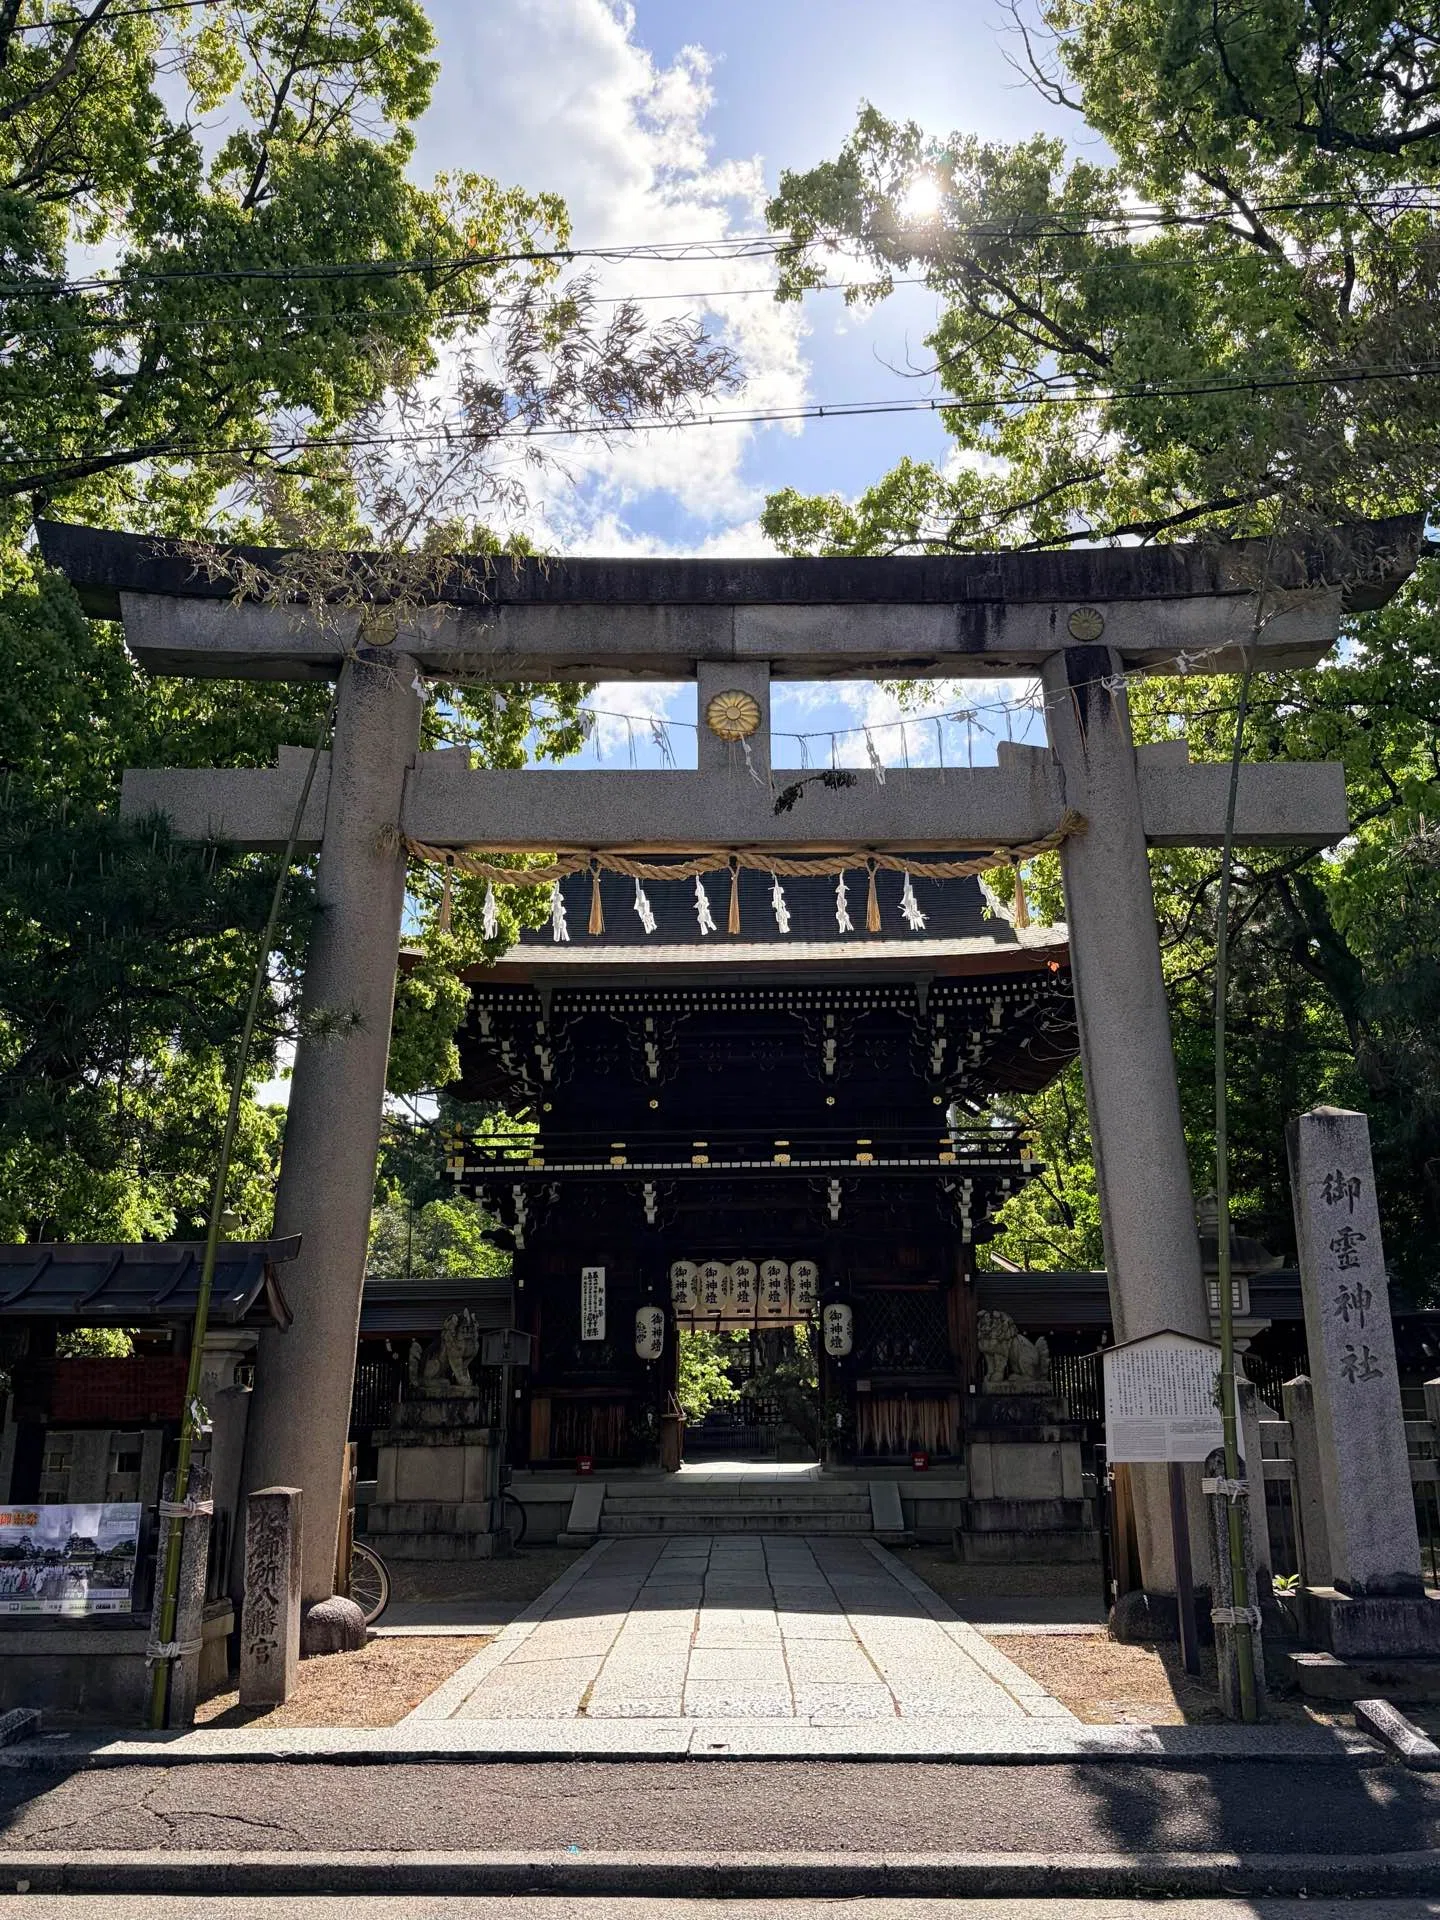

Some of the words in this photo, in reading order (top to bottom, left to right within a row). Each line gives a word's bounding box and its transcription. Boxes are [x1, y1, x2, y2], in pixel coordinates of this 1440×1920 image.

[674, 1266, 688, 1303] 御神燈
[704, 1267, 718, 1304] 御神燈
[733, 1265, 750, 1303] 御神燈
[767, 1265, 781, 1303] 御神燈
[798, 1266, 812, 1303] 御神燈
[651, 1313, 662, 1351] 御神燈
[831, 1310, 844, 1349] 御神燈
